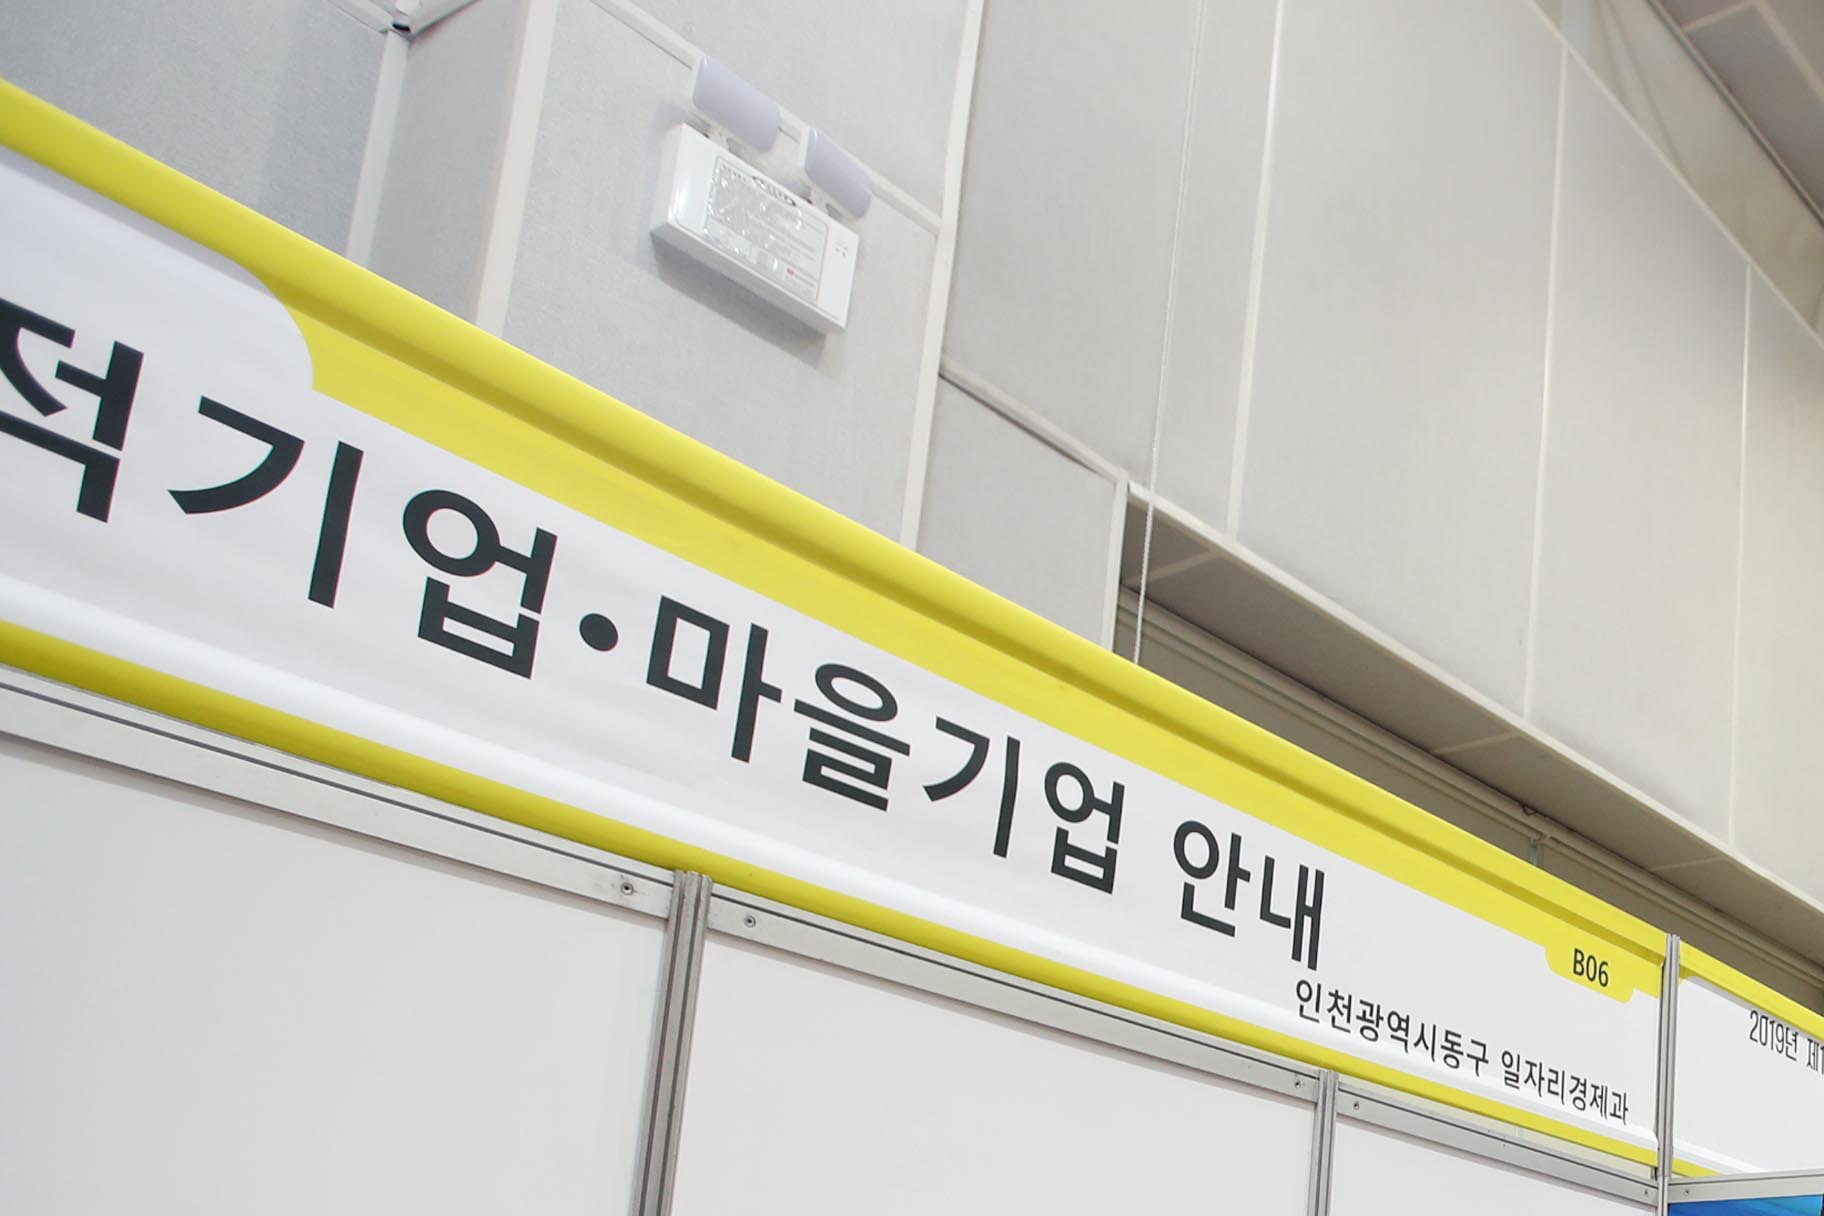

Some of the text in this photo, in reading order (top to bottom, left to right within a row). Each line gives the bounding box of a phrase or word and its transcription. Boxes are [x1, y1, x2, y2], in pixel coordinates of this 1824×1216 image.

[1173, 819, 1325, 971] 안내
[1572, 947, 1610, 988] B06
[1296, 979, 1629, 1126] 인천광역시동구 일자리경제과
[1750, 1010, 1798, 1061] 2019년
